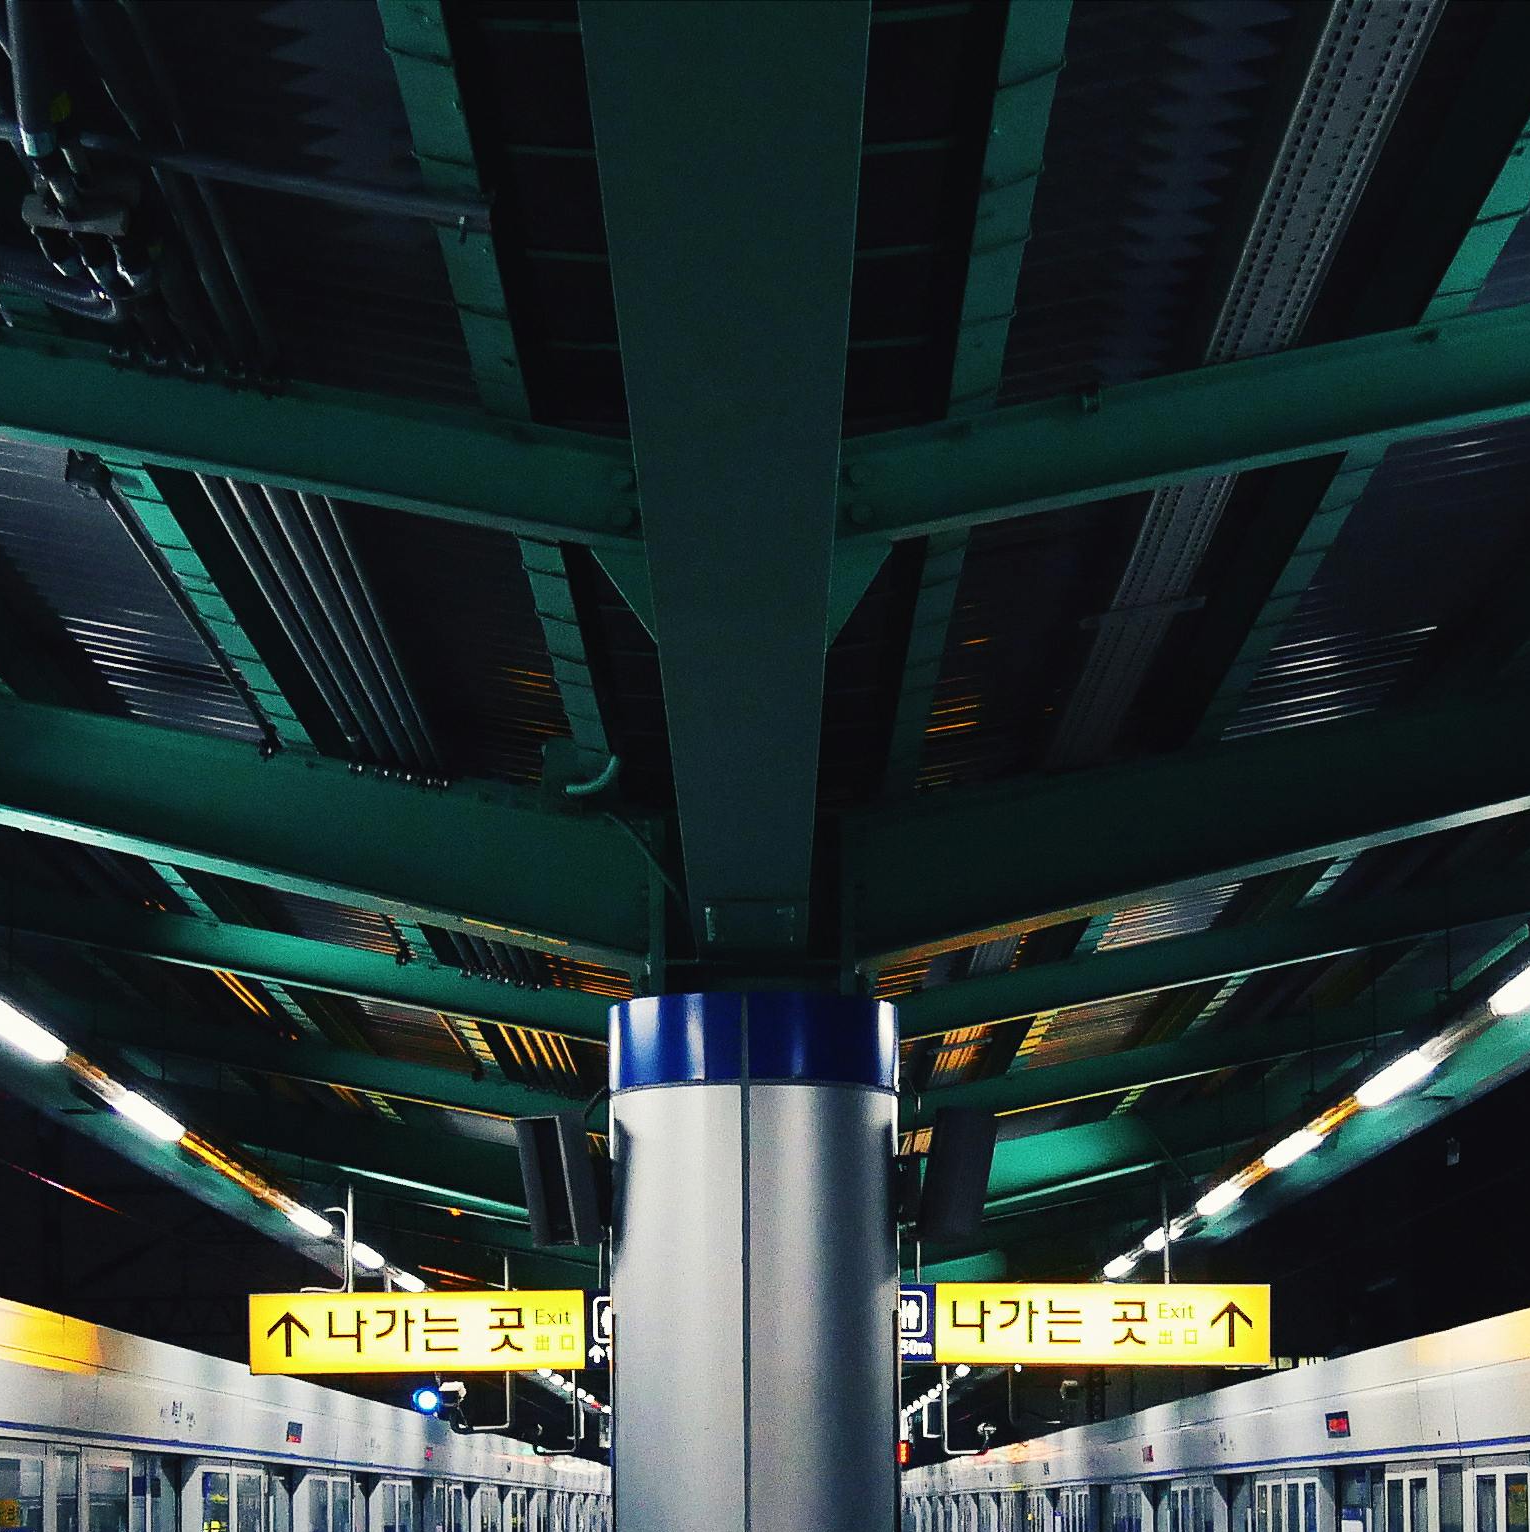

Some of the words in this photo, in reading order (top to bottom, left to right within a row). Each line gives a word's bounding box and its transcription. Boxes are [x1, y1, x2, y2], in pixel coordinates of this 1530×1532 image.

[535, 1308, 572, 1326] Exit
[952, 1300, 1083, 1343] 나가는
[1112, 1301, 1148, 1345] 곳
[1158, 1302, 1197, 1320] Exit
[328, 1308, 459, 1353] 나가는
[489, 1307, 525, 1352] 곳
